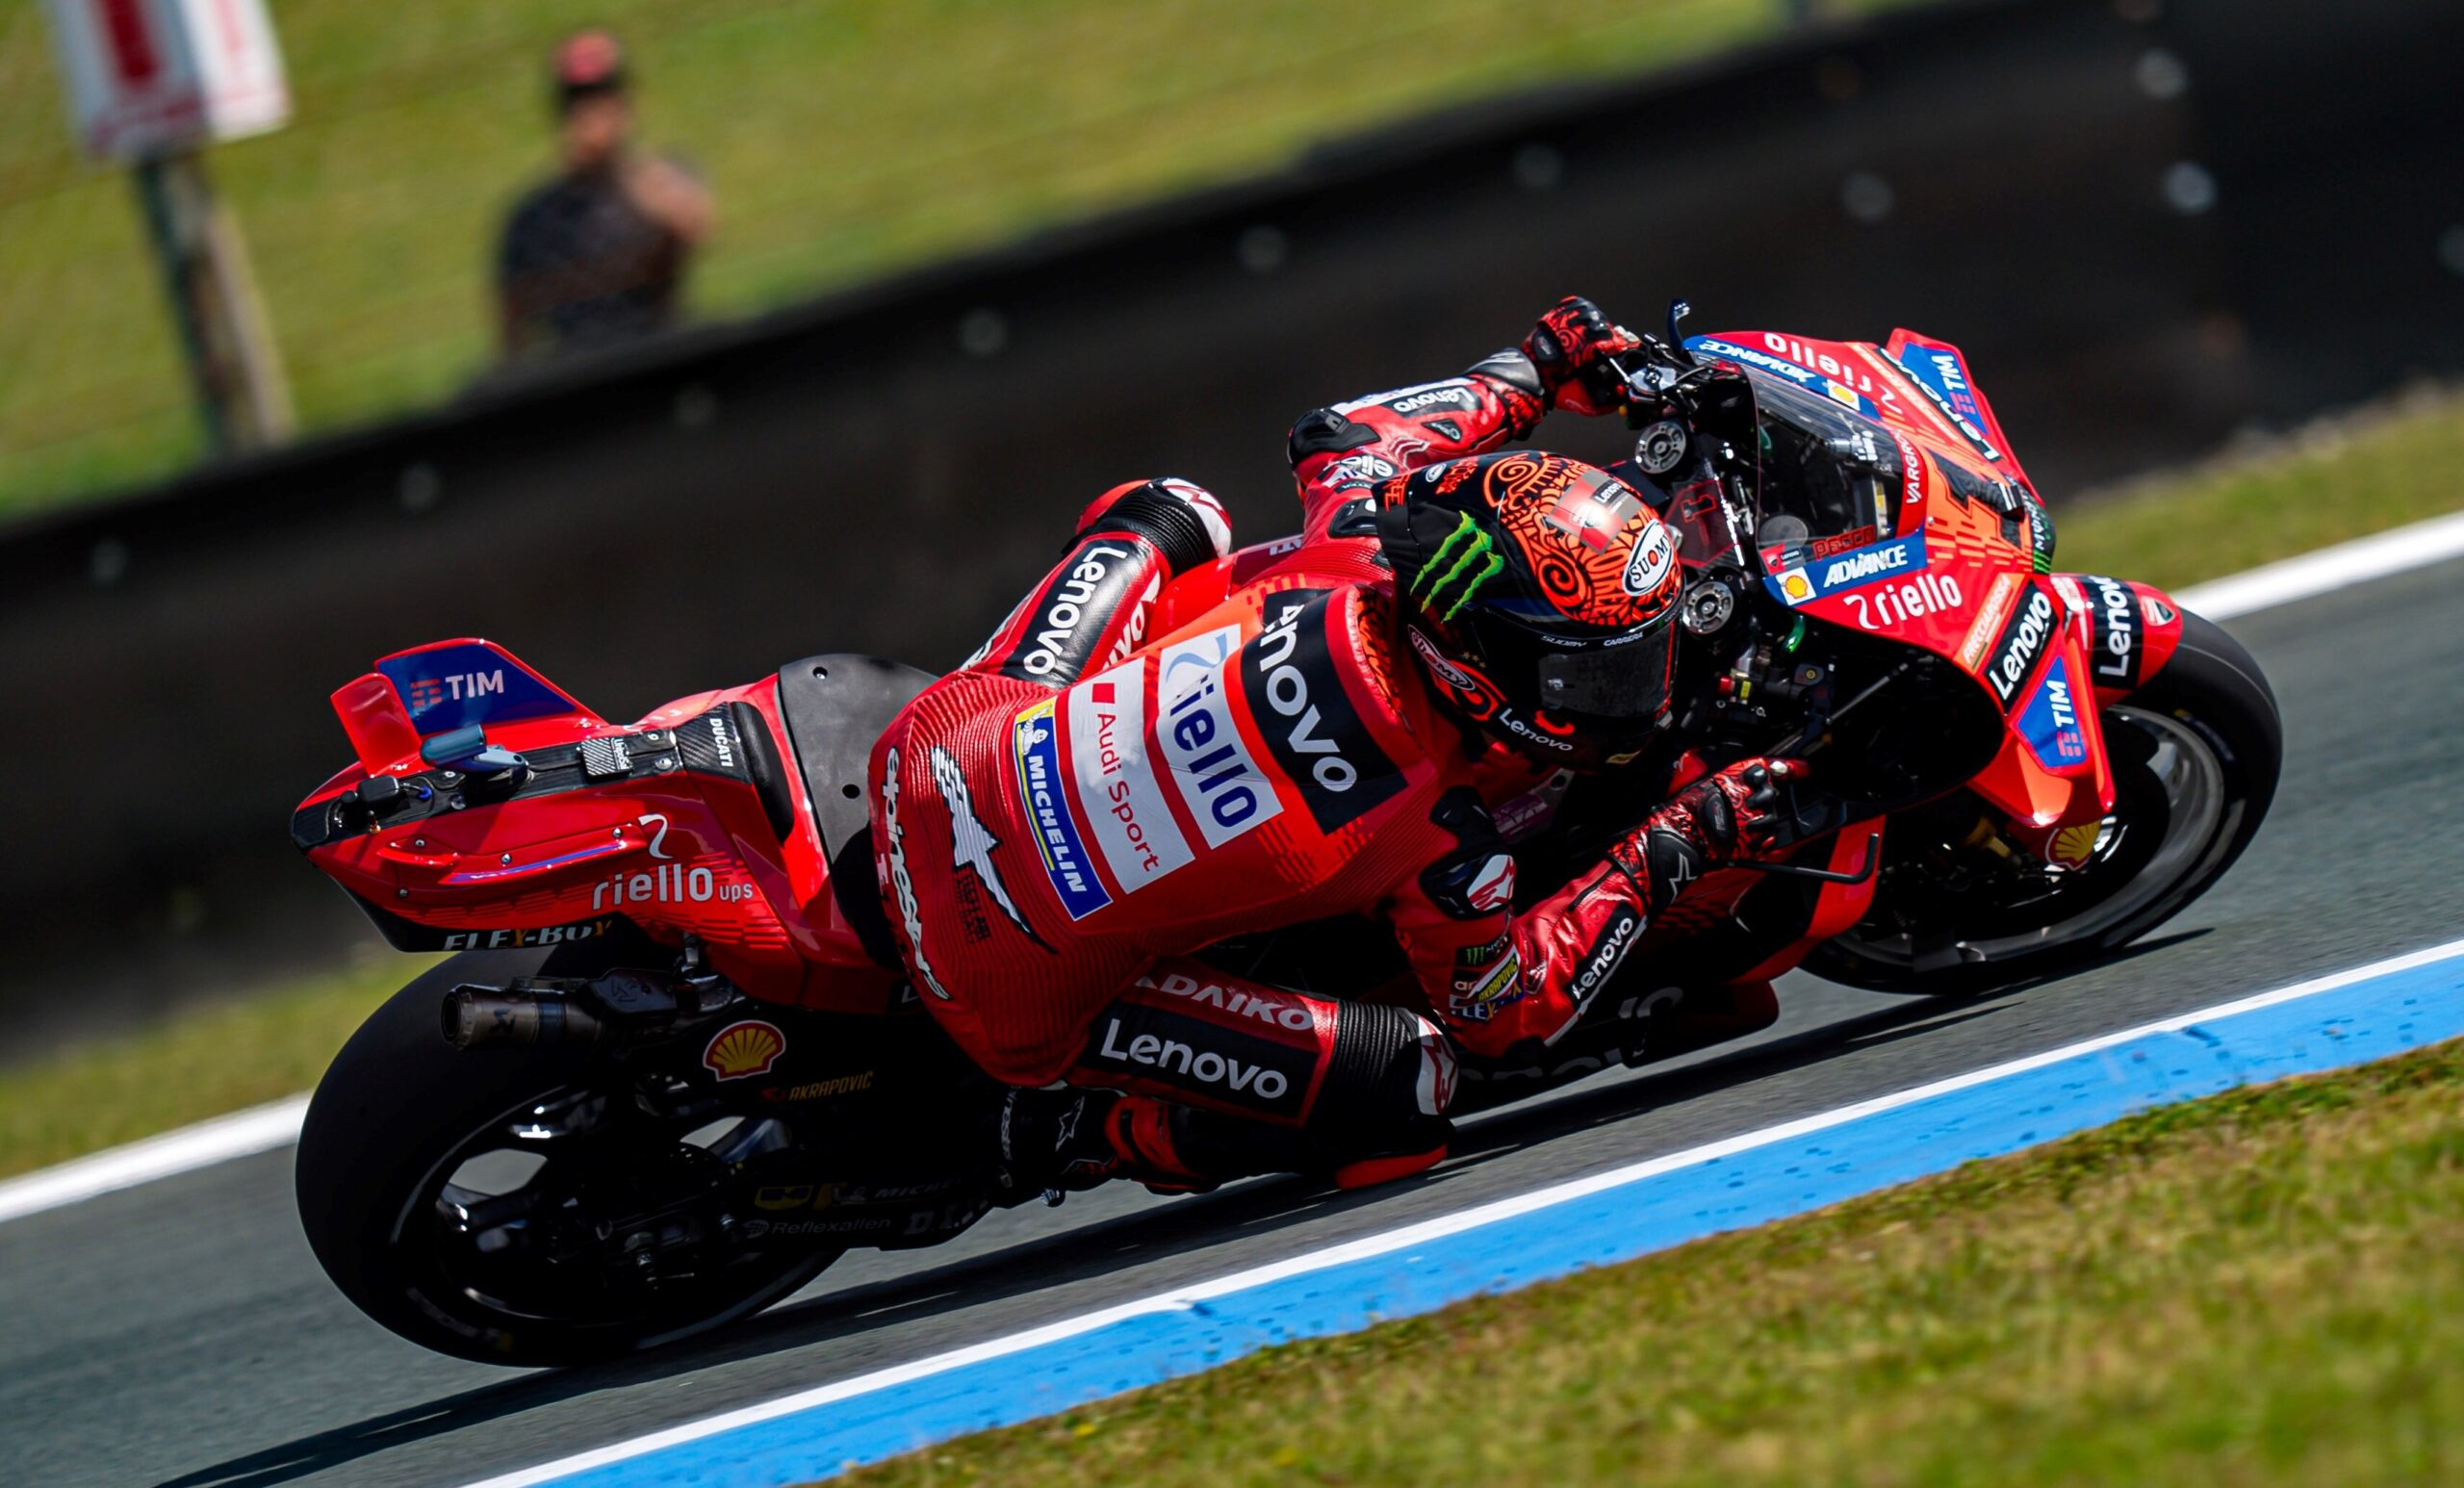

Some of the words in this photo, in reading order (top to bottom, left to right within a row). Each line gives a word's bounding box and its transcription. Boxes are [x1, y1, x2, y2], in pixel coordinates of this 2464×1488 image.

[1699, 340, 1816, 382] ADVANCE
[1764, 333, 1871, 393] riello
[1931, 355, 1965, 391] TIM
[1393, 387, 1475, 412] Lenovo
[1880, 347, 2000, 460] Lenovo
[1823, 545, 1908, 588] ADVANCE
[1023, 546, 1128, 676] Lenovo
[1875, 574, 1963, 626] riello
[2088, 576, 2132, 677] Lenov
[1989, 591, 2052, 701] Lenovo
[445, 669, 504, 701] TIM
[2046, 679, 2074, 728] TIM
[709, 717, 733, 767] DUCATI
[1096, 712, 1121, 776] Audi
[1499, 706, 1574, 752] Lenovo
[1028, 755, 1088, 893] MICHELIN
[1108, 779, 1160, 873] Sport
[591, 862, 714, 911] riello
[718, 882, 755, 904] ups
[1572, 916, 1634, 1000] Lenovo
[1159, 973, 1315, 1032] DAIKO
[1100, 1017, 1289, 1099] Lenovo
[771, 1217, 892, 1236] Reflexallen
